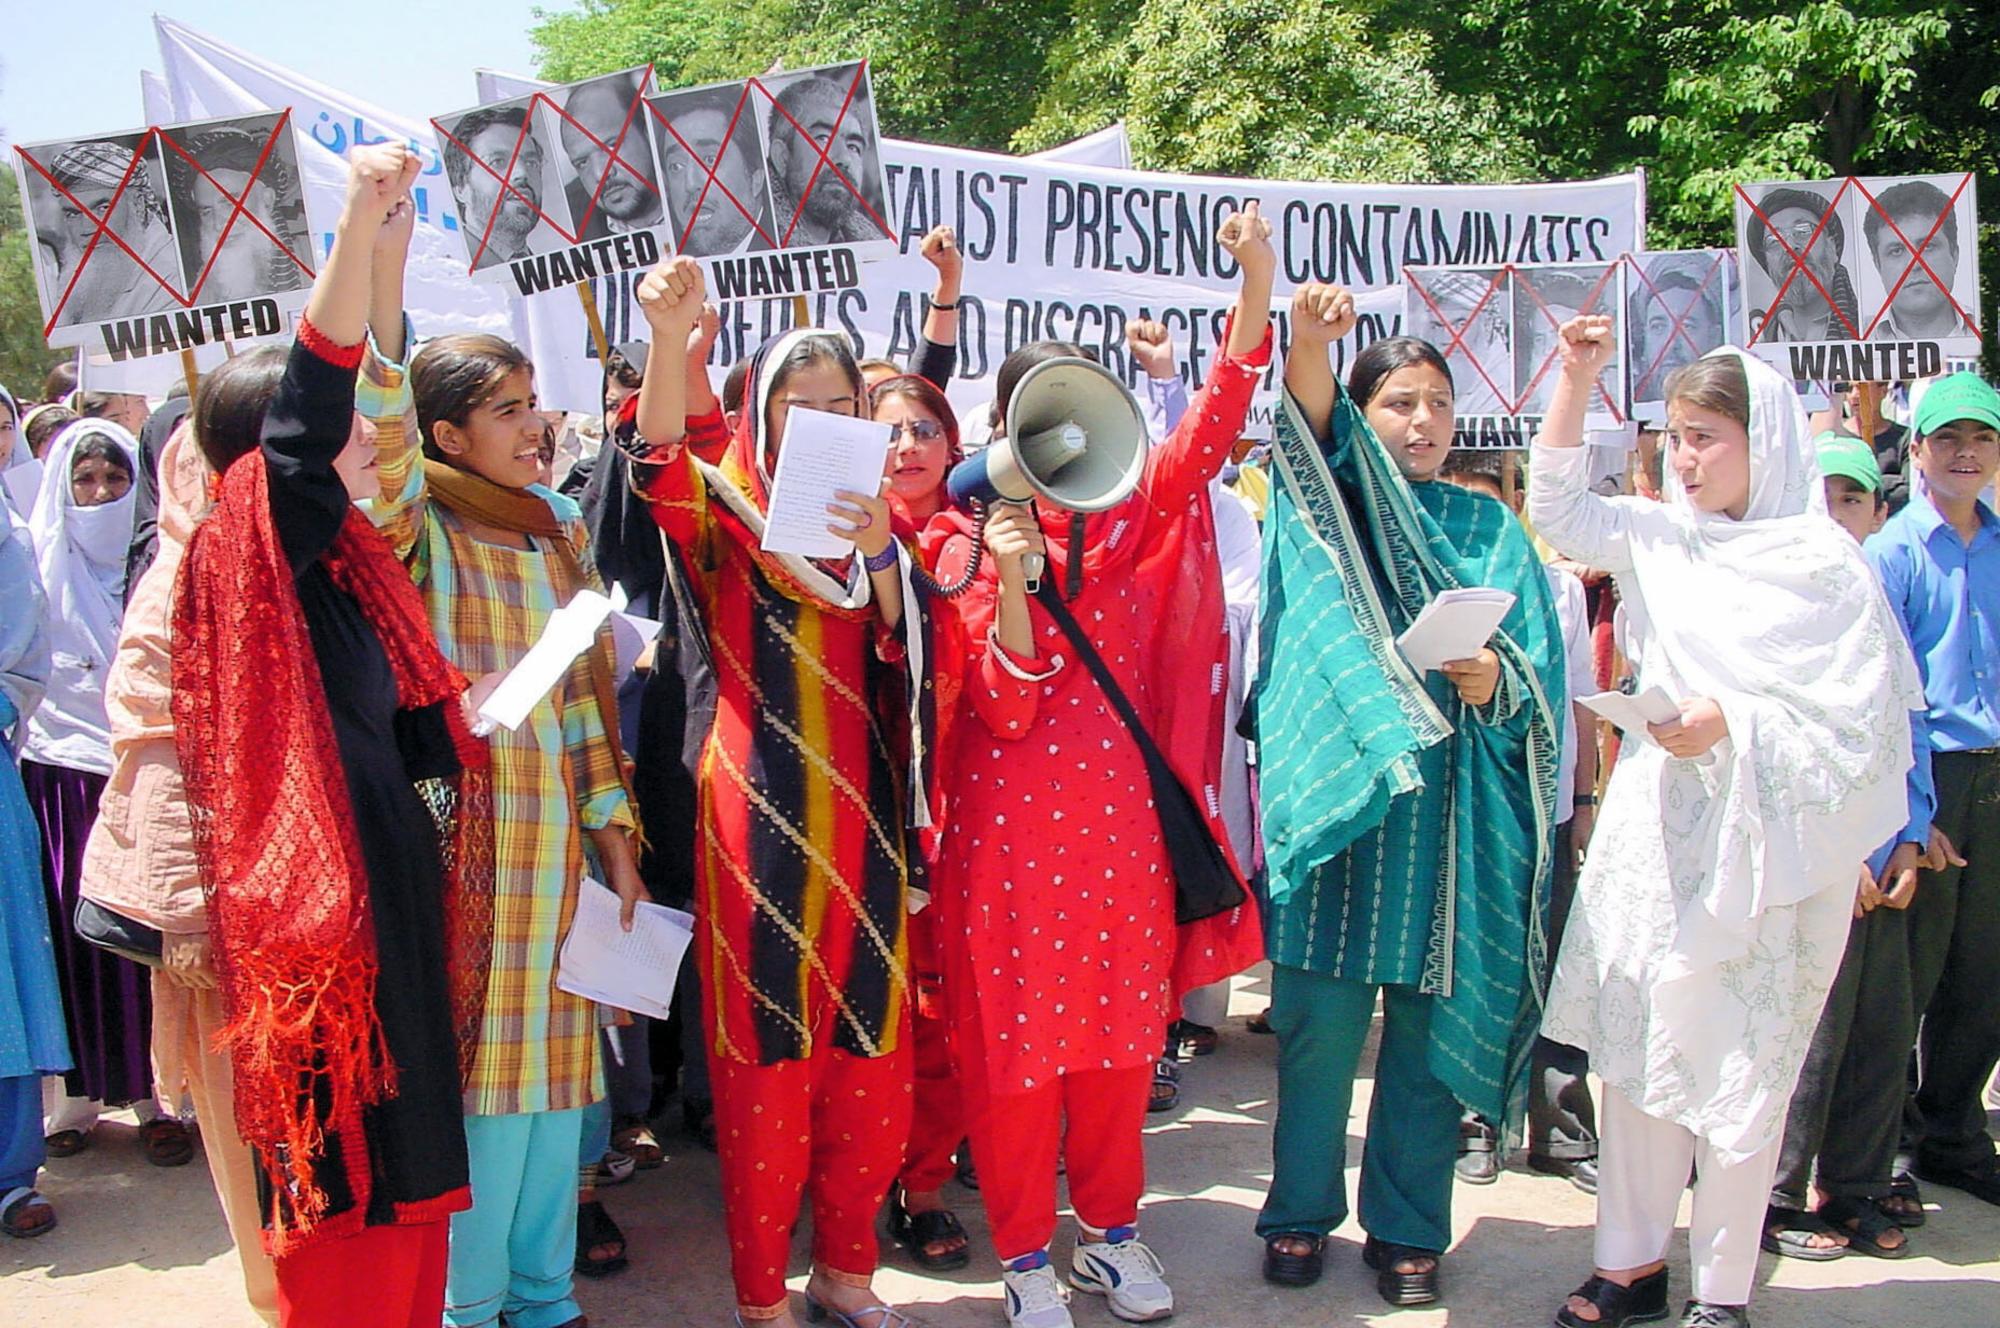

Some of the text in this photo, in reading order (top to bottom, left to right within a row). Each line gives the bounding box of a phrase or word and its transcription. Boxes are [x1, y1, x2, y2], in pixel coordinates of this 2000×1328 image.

[1045, 178, 1261, 279] PRESENC
[511, 230, 660, 296] WANTED
[711, 248, 858, 300] WANTED
[100, 298, 281, 363] WANTED
[1789, 341, 1941, 381] WANTED
[1451, 416, 1542, 448] WANT
